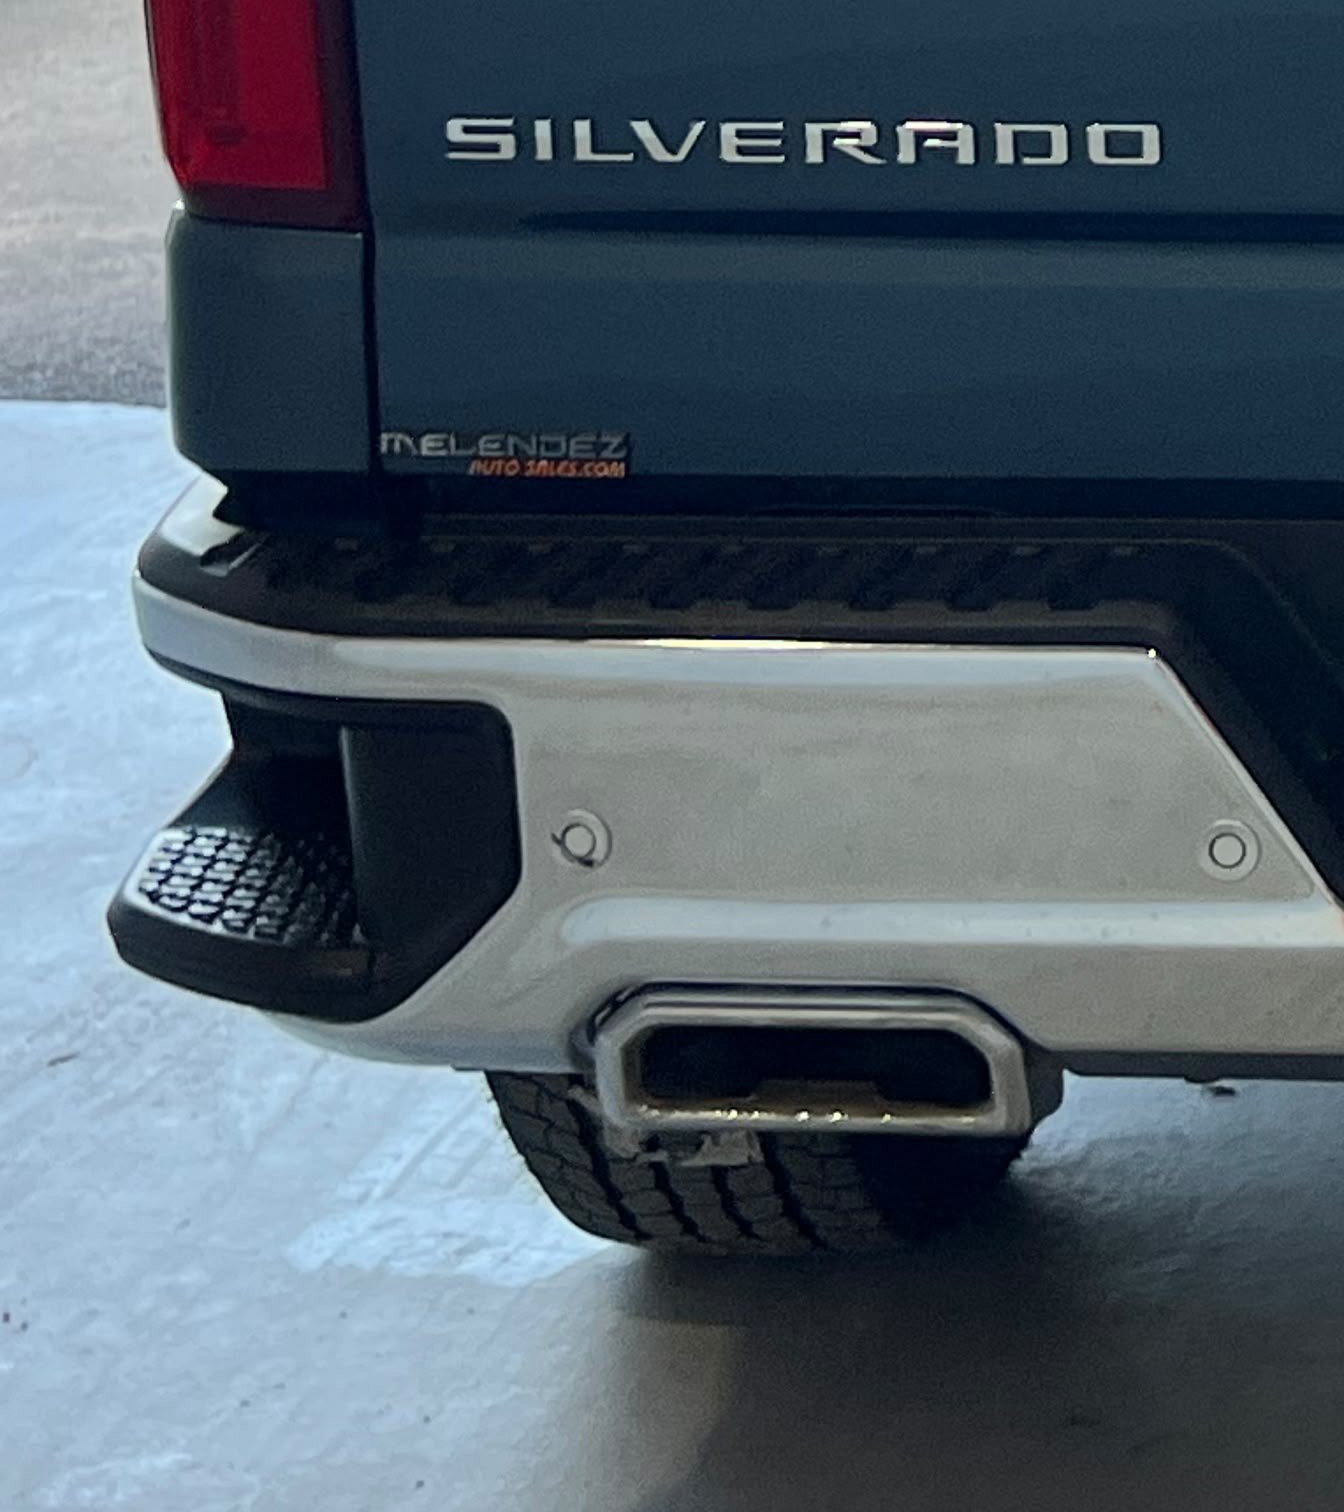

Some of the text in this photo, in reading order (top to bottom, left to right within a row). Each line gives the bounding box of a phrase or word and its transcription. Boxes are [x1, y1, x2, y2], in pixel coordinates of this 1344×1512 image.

[444, 115, 1163, 167] SILVERADO
[379, 431, 628, 459] MELENDEZ
[468, 458, 626, 478] AUTO SALES.COM
